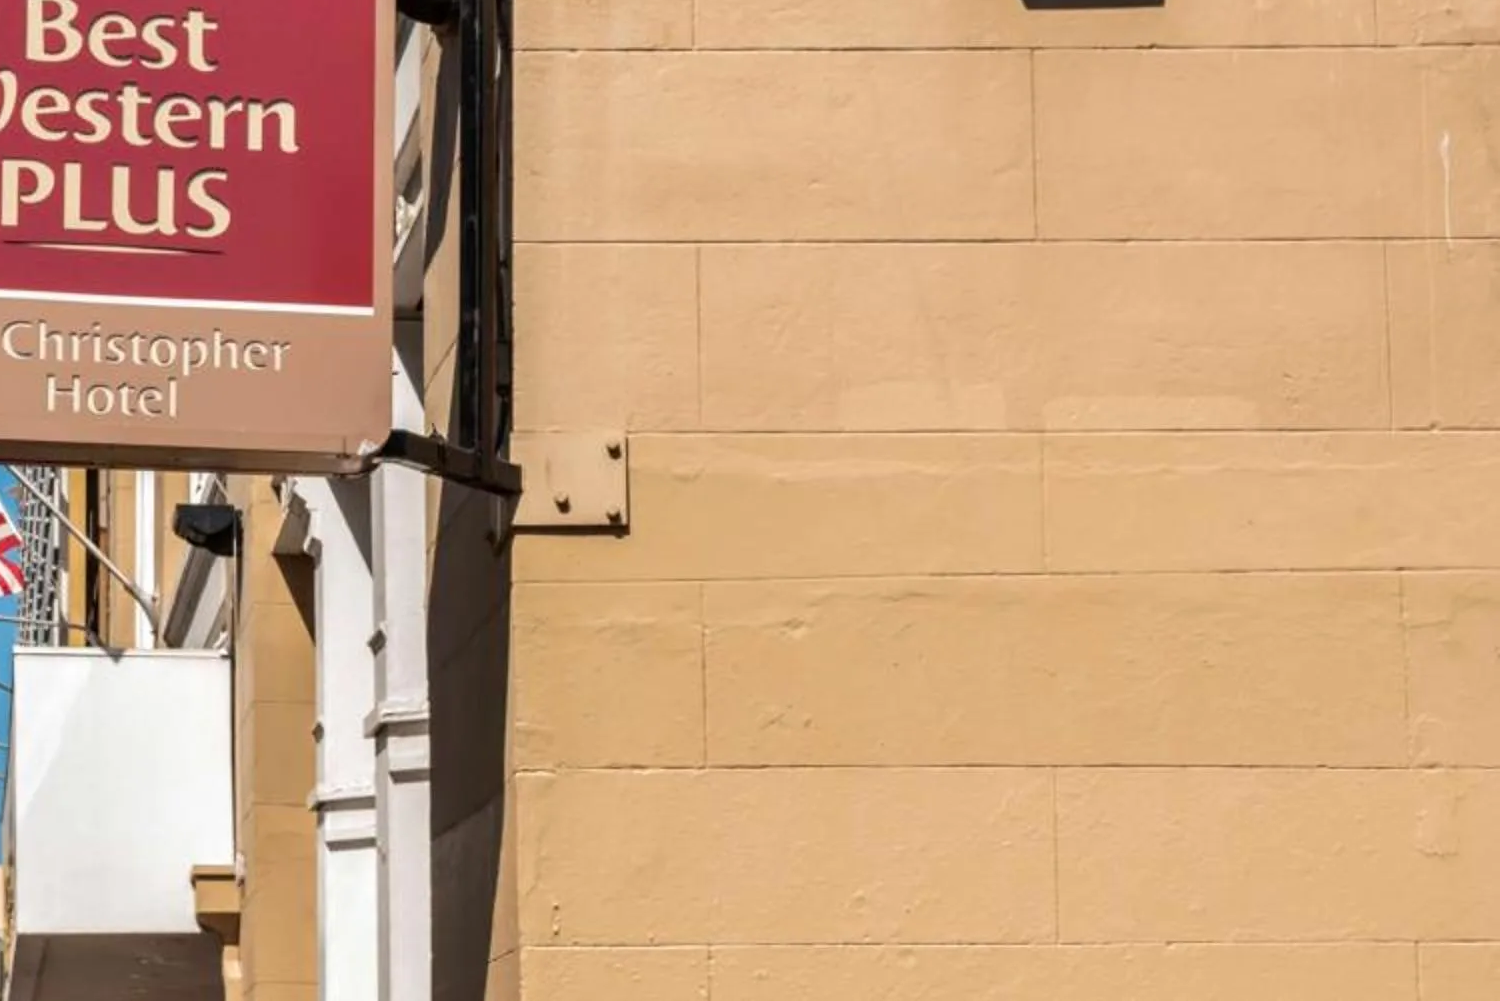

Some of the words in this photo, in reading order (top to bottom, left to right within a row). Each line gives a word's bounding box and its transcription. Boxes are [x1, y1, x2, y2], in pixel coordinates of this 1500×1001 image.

[0, 158, 232, 239] PLUS
[1, 319, 291, 376] Christopher
[46, 373, 178, 419] Hotel
